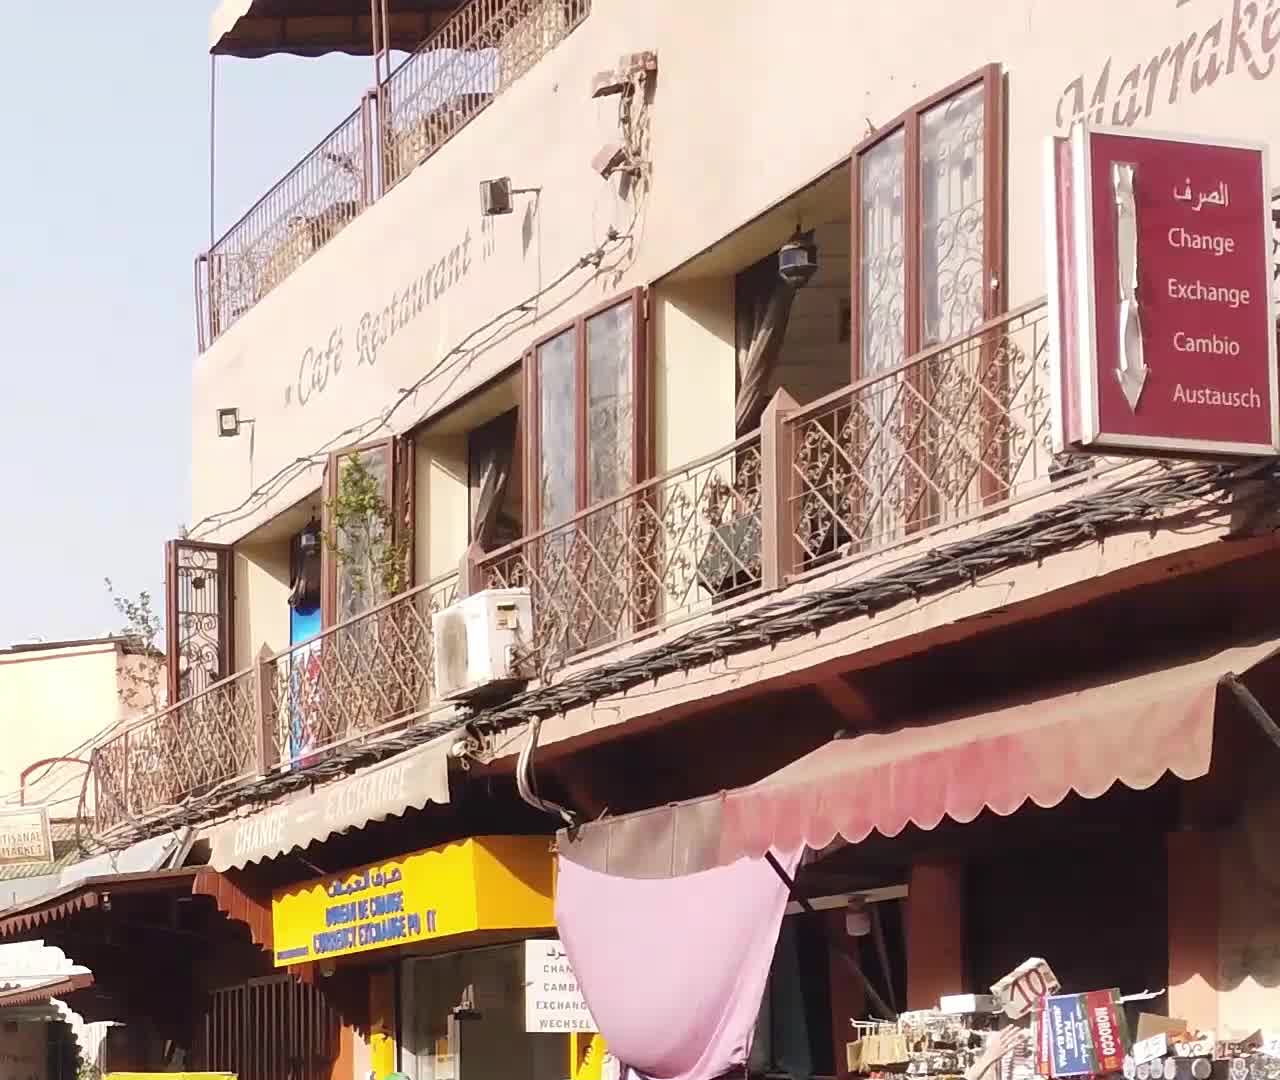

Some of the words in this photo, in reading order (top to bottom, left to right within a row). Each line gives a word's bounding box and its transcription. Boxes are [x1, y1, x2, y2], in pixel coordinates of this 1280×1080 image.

[1174, 177, 1229, 211] الصرف
[1168, 227, 1235, 256] Change
[356, 224, 472, 366] Restaurant
[1168, 278, 1250, 308] Exchange
[1173, 331, 1240, 356] Cambio
[1173, 383, 1261, 408] Austausch
[543, 964, 574, 974] CHAN
[543, 982, 581, 992] CAMBI
[536, 1000, 588, 1010] EXCHANG
[539, 1019, 592, 1030] WECHSEL
[1093, 1006, 1116, 1056] MOROCCO
